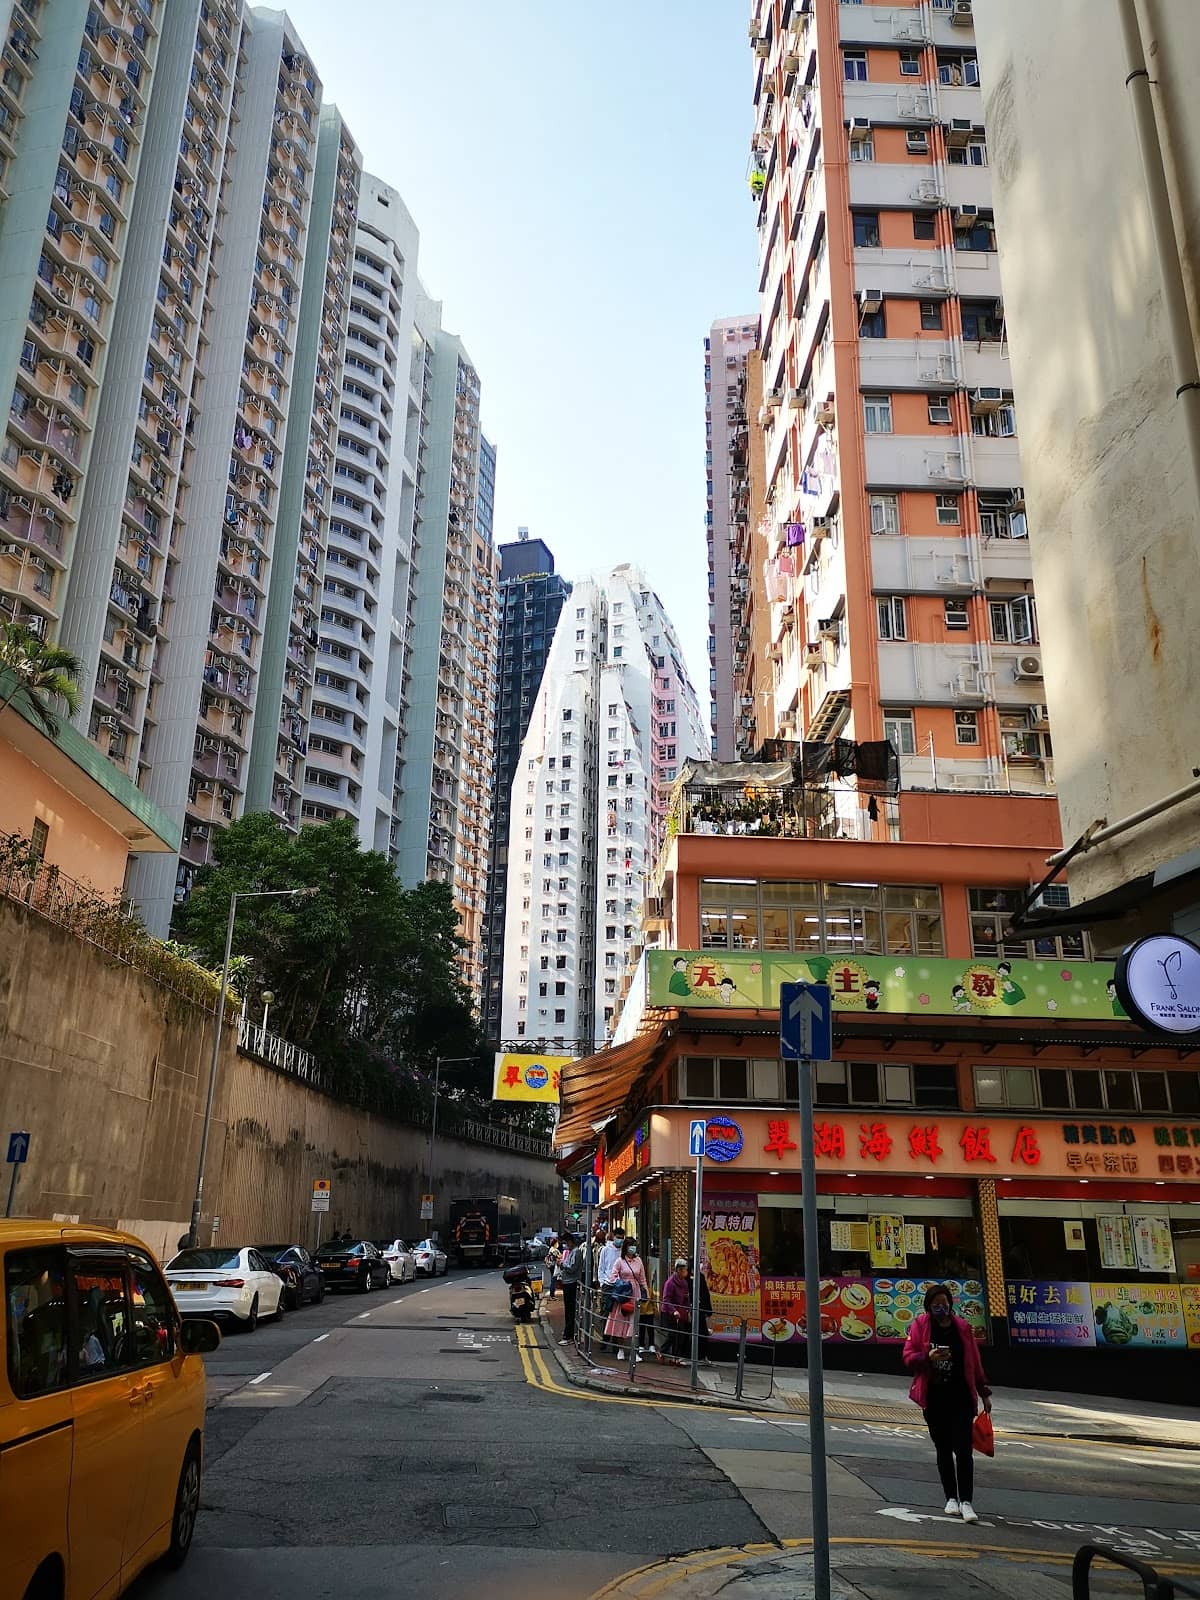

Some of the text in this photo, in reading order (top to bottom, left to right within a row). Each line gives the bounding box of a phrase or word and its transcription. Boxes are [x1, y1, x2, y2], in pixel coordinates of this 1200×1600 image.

[1150, 1002, 1176, 1012] FRANK
[707, 1125, 736, 1139] TW
[763, 1119, 1041, 1165] 翠湖海鮮飯店
[1066, 1151, 1139, 1174] 早午茶市
[700, 1213, 755, 1231] 外賣特價
